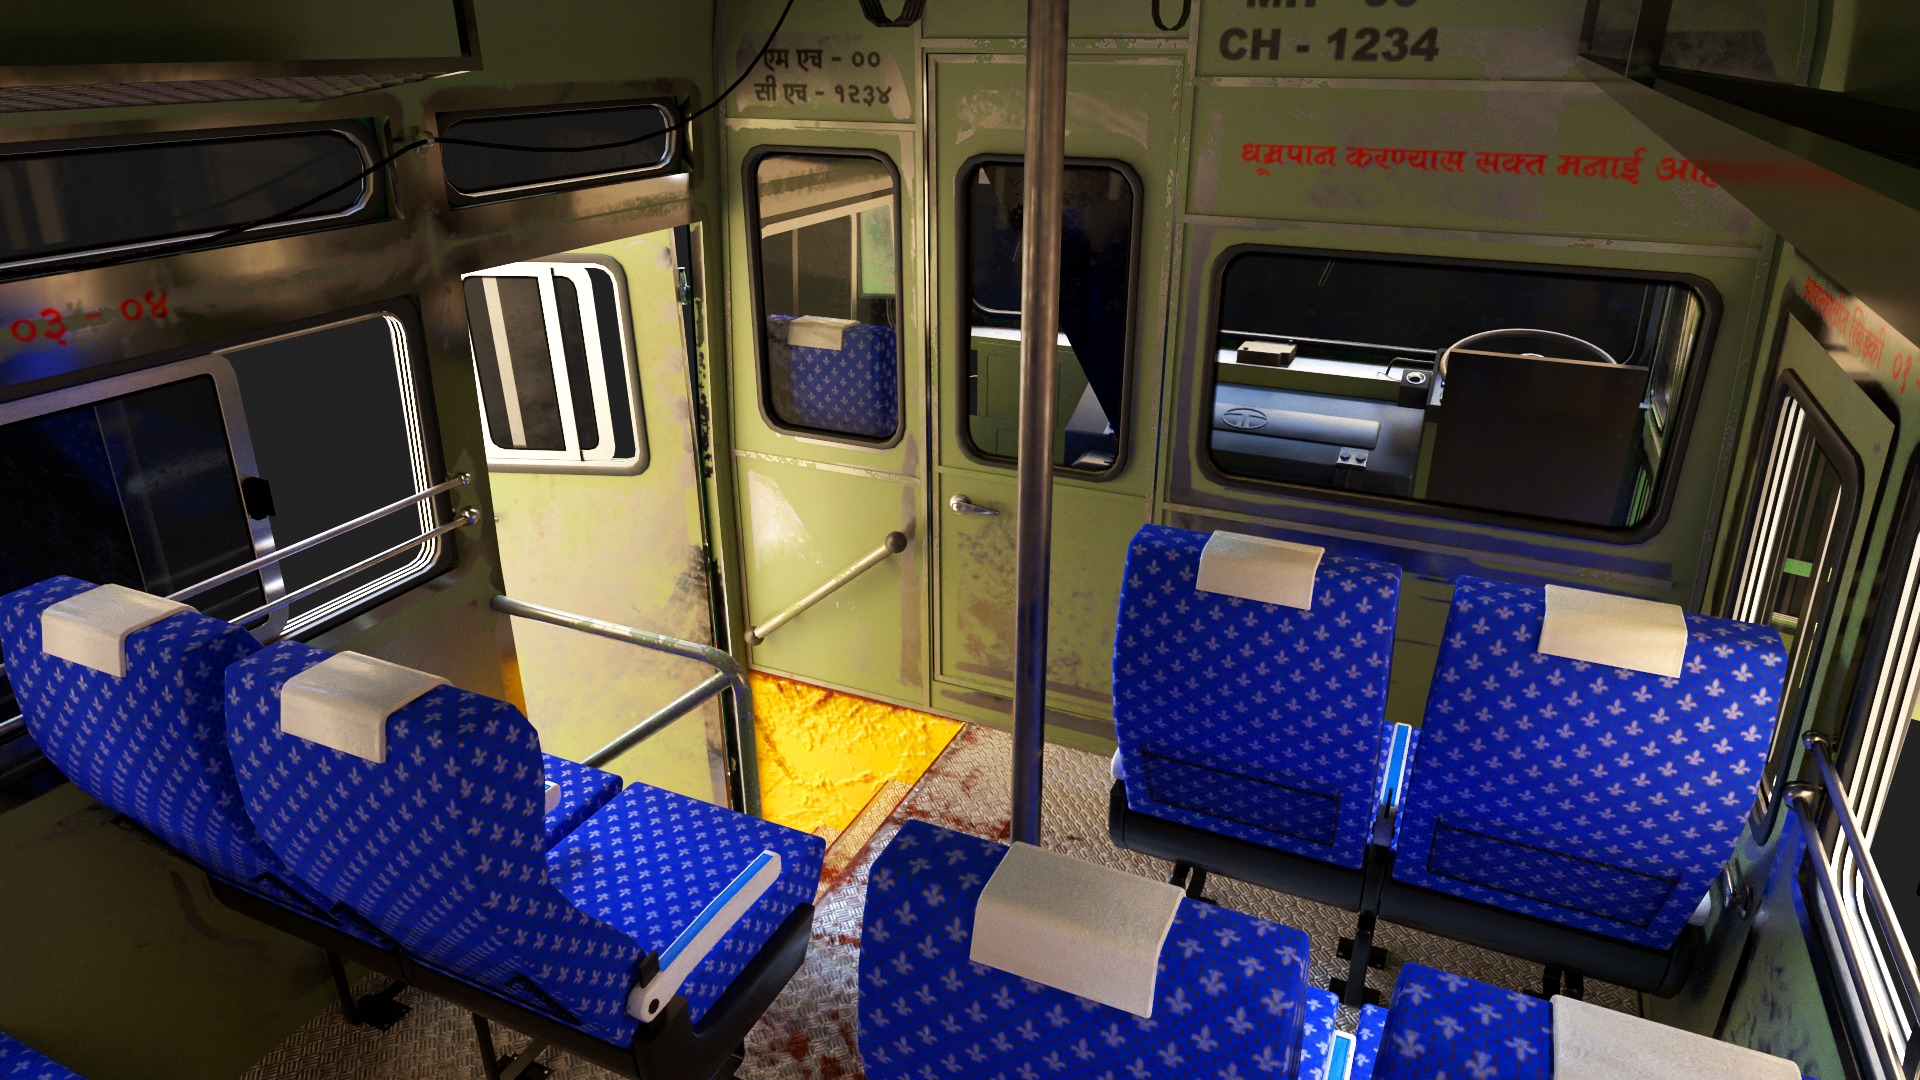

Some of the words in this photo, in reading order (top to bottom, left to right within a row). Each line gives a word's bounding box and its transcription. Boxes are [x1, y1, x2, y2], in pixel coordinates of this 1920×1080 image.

[763, 49, 790, 72] एम
[796, 49, 823, 72] एच
[1218, 27, 1282, 61] CH
[1296, 44, 1311, 53] -
[1327, 27, 1440, 62] 1234
[754, 75, 777, 101] सी
[783, 84, 808, 105] एच
[835, 84, 892, 107] १२३४
[1241, 143, 1339, 177] धूम्रपान
[1345, 147, 1467, 172] करण्यास
[1476, 151, 1549, 176] सक्त
[1557, 147, 1648, 185] मनाई
[10, 307, 67, 346] ०३
[85, 311, 102, 320] -
[120, 288, 168, 321] ०४
